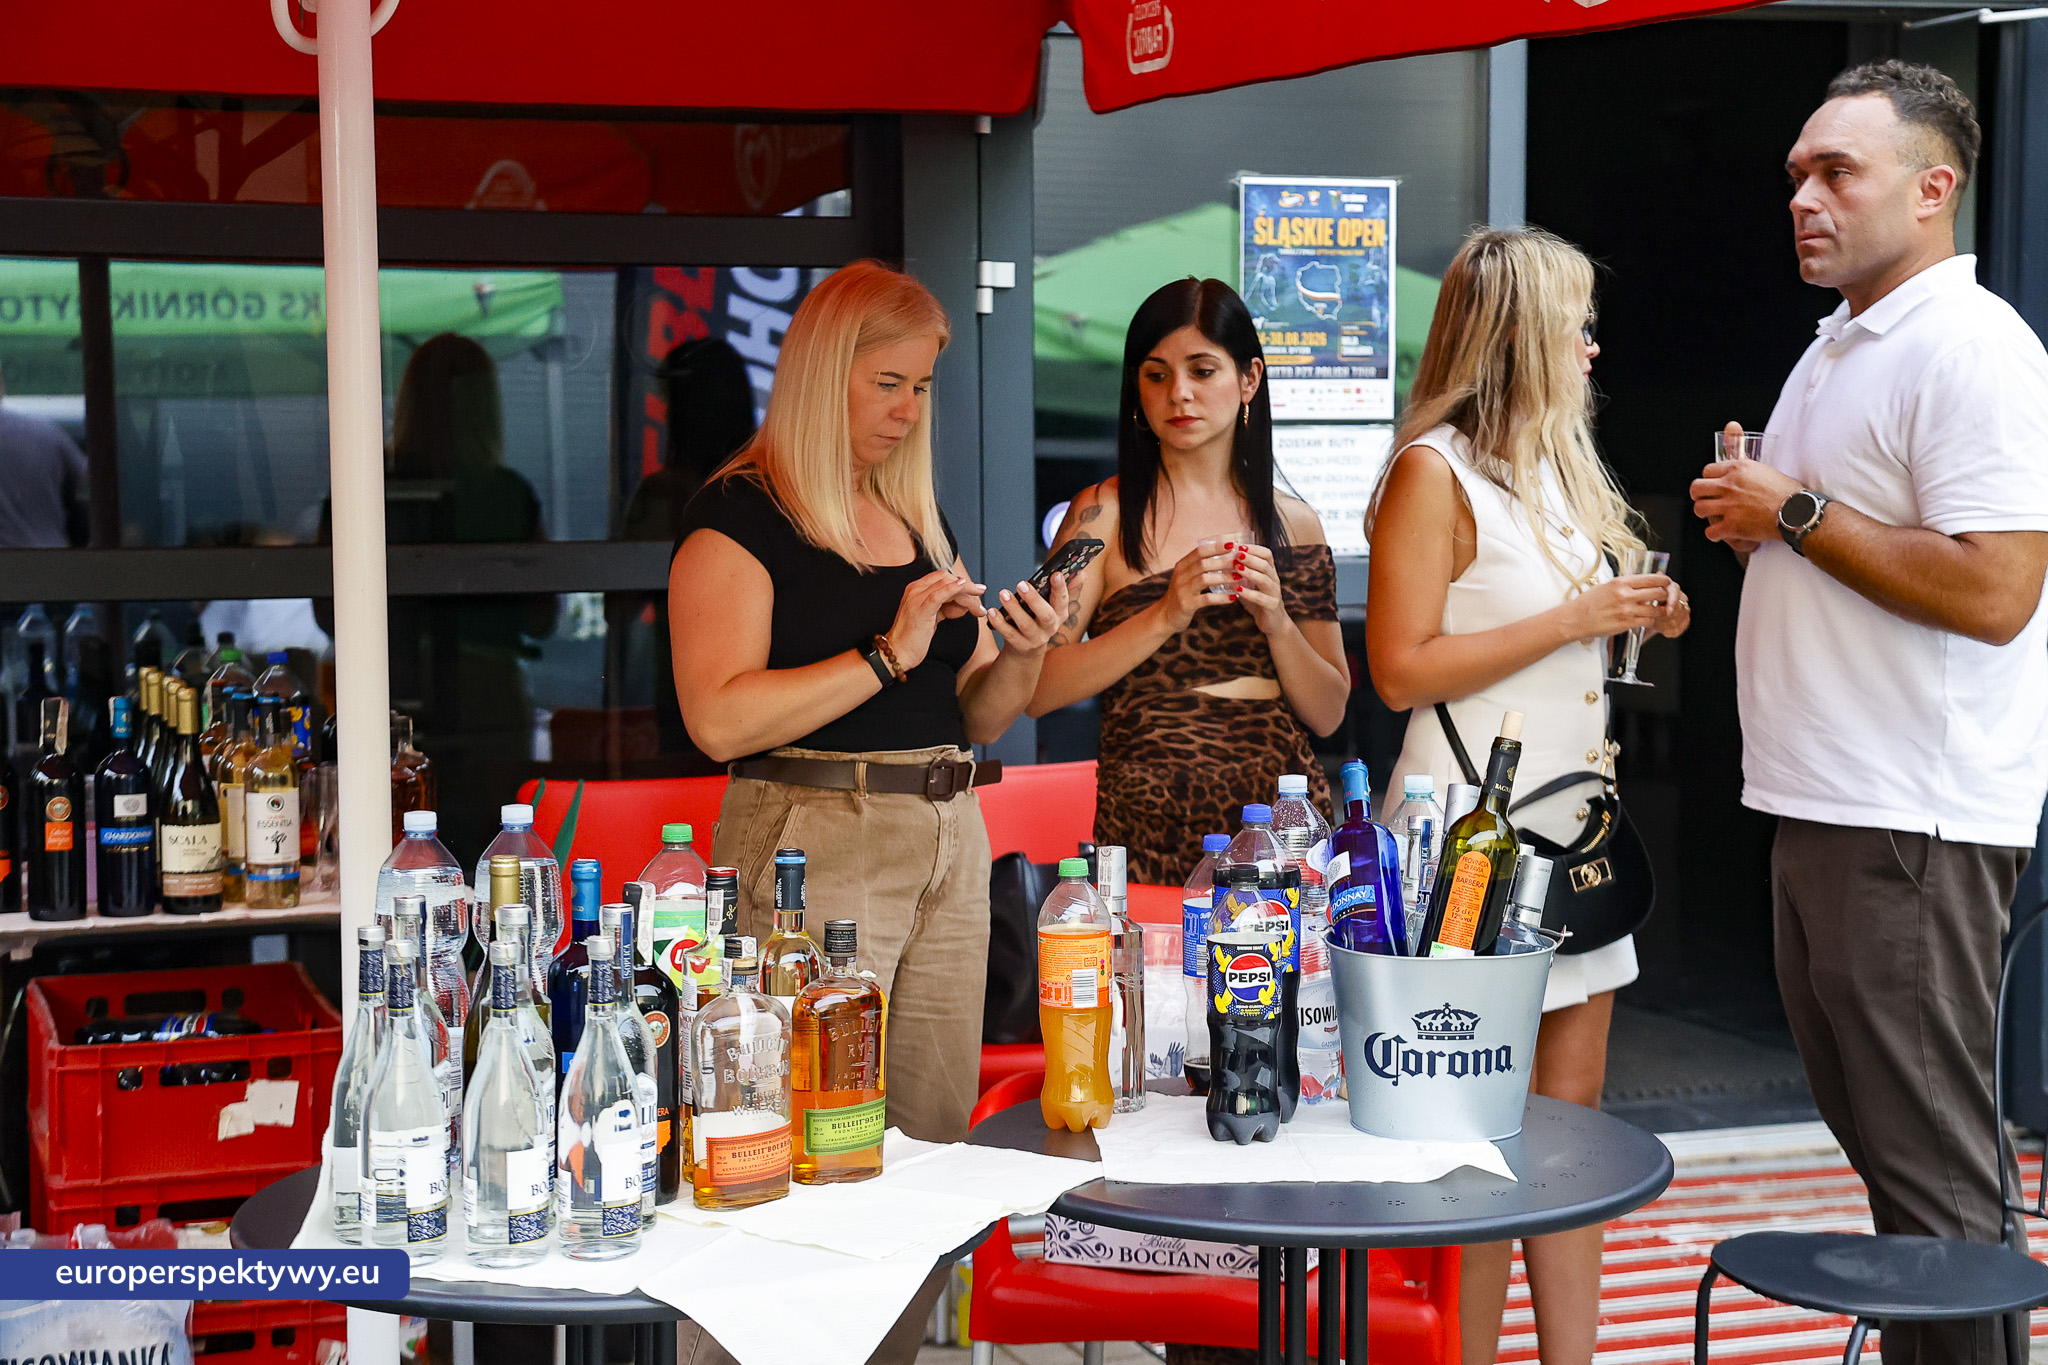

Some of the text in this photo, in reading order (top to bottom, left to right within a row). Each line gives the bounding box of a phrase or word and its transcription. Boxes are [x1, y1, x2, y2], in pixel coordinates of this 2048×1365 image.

[1254, 210, 1387, 249] ŚLĄSKIE OPEN
[1278, 438, 1357, 448] ZOSTAW BUTY
[1455, 876, 1485, 889] BARBERA
[621, 942, 632, 979] SOPLICA
[1228, 972, 1271, 983] PEPSI
[1298, 1006, 1337, 1027] ISOWI
[1363, 1032, 1513, 1087] Corona
[831, 1119, 862, 1130] BULLEIT
[864, 1116, 874, 1124] 95
[731, 1148, 765, 1159] BULLEIT
[1118, 1246, 1211, 1269] BOCIAN
